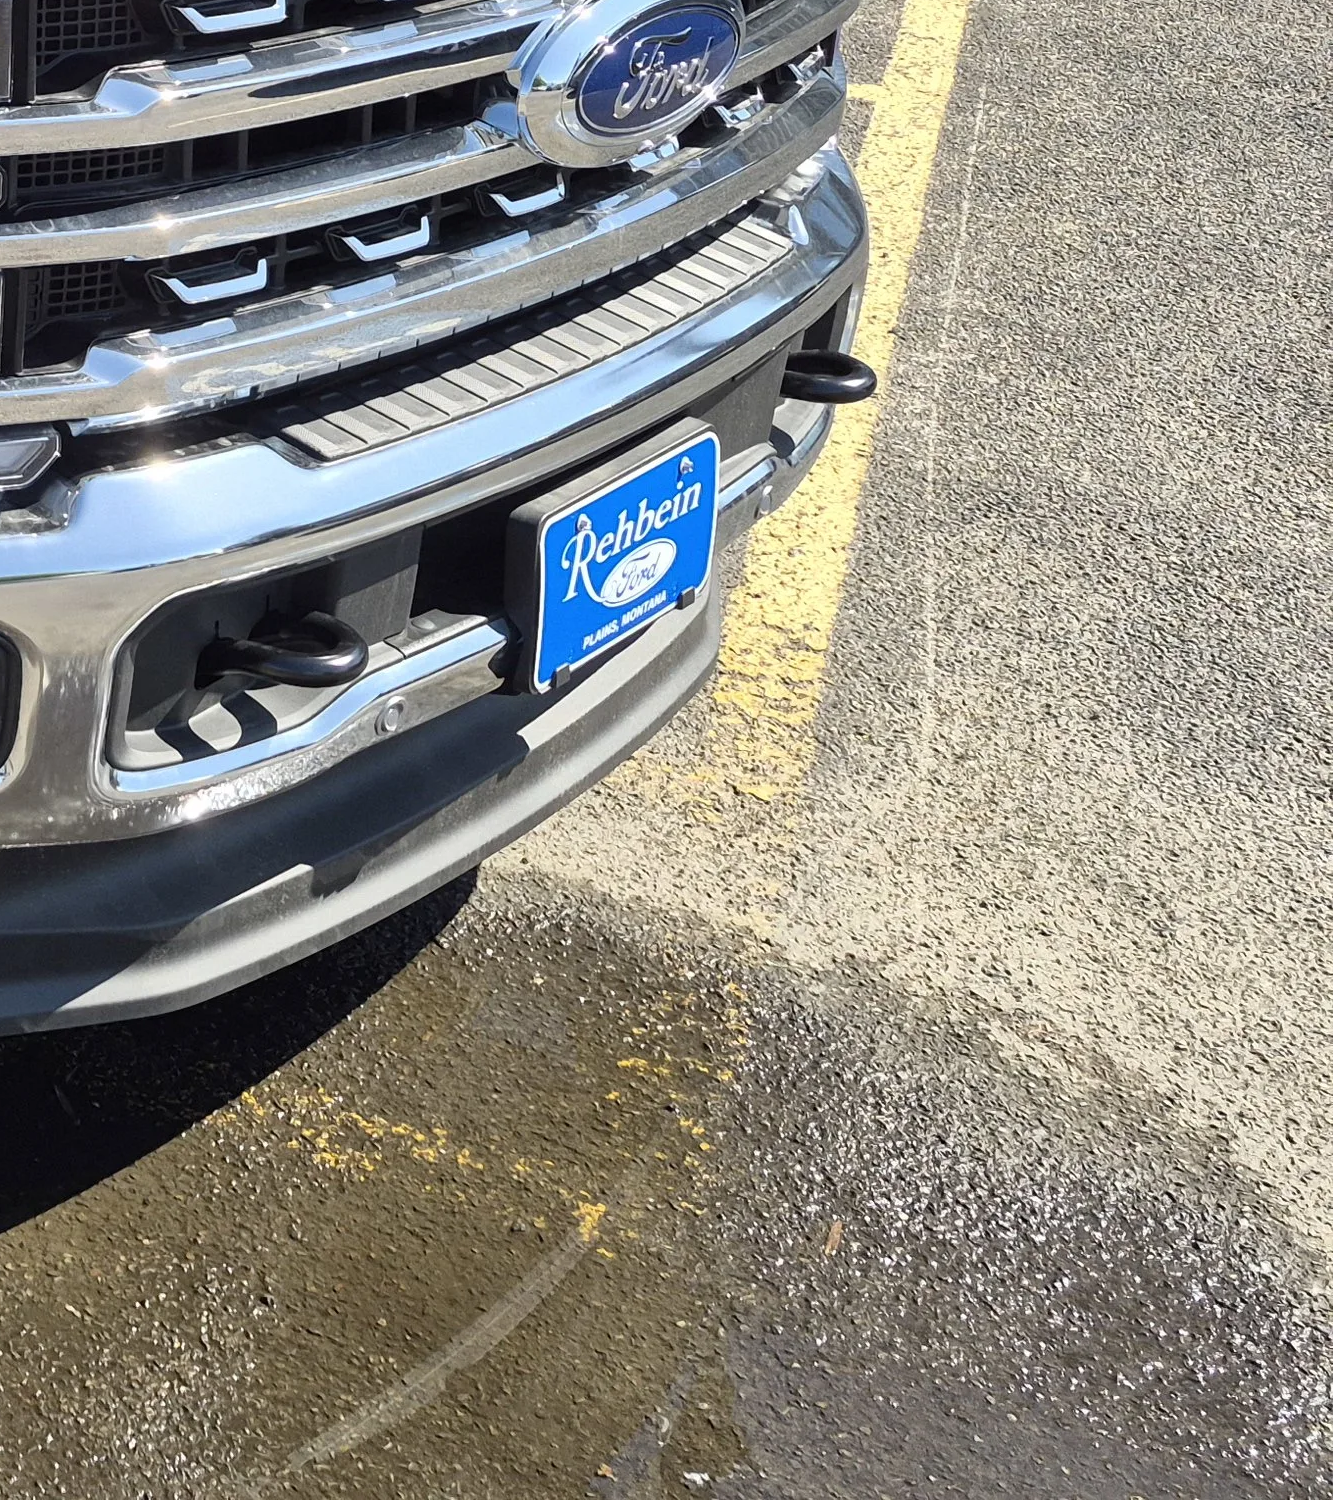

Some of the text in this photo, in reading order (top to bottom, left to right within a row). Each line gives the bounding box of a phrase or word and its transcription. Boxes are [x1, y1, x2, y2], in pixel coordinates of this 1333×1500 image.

[613, 26, 715, 120] Ford
[561, 481, 702, 603] Rehbein
[612, 554, 660, 599] Ford
[582, 589, 668, 651] PLAINS, MONTANA
